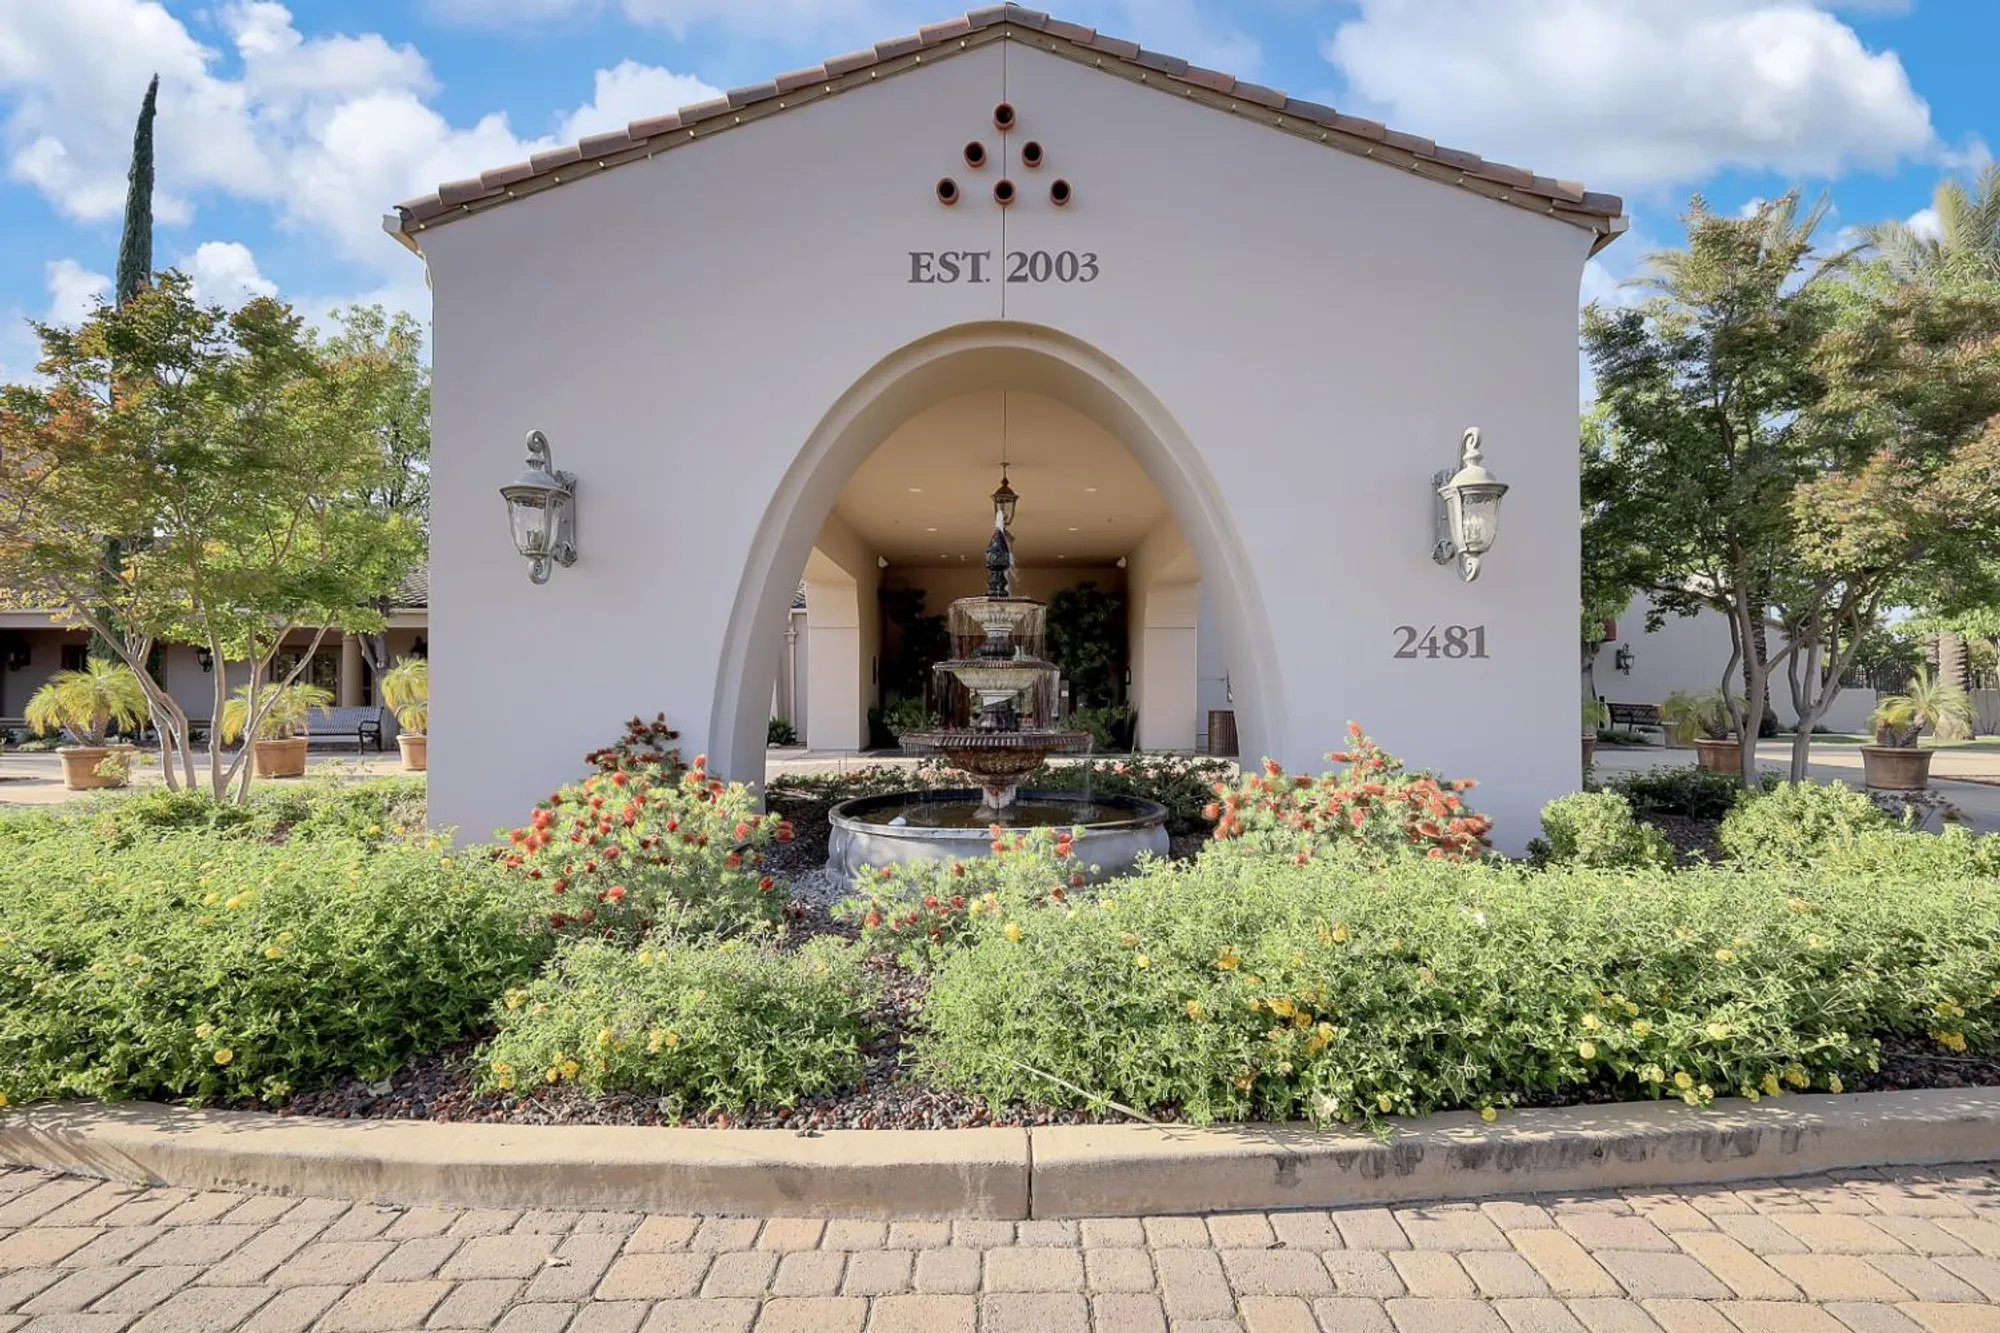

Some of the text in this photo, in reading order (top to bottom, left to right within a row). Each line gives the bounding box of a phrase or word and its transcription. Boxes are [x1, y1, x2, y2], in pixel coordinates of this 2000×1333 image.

[907, 250, 1100, 284] EST. 2003
[1393, 625, 1490, 659] 2481
